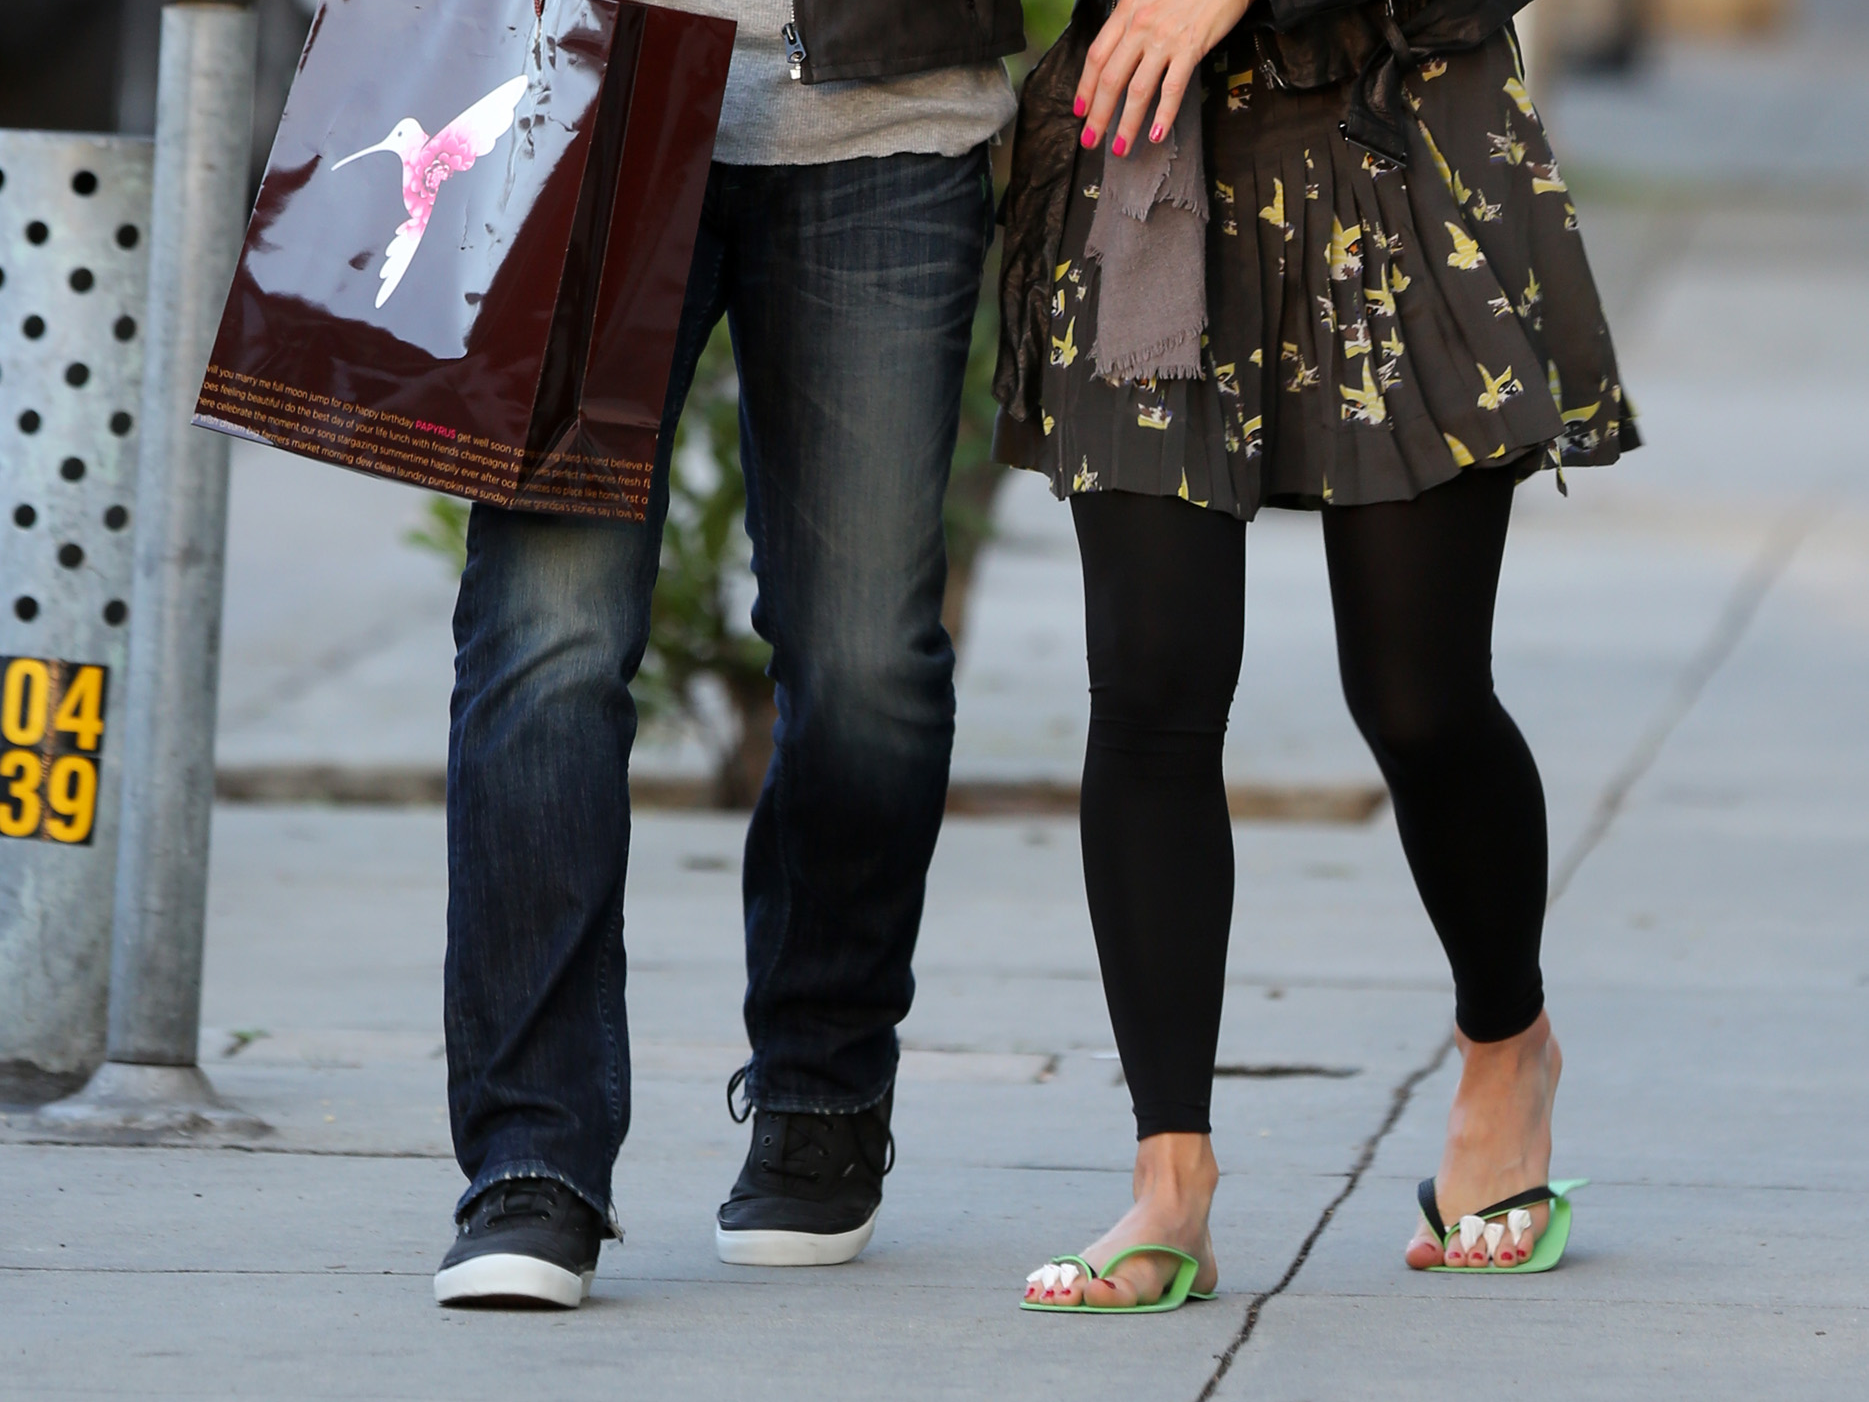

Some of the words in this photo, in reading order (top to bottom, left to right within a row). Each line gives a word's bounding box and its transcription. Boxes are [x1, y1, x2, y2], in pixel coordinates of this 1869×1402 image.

[216, 402, 253, 419] celebrate
[253, 411, 267, 422] the
[267, 416, 300, 432] moment
[301, 425, 316, 435] our
[317, 429, 336, 442] song
[337, 434, 378, 454] stargazing
[379, 444, 429, 467] summertime
[430, 458, 460, 476] happily
[461, 468, 480, 479] ever
[480, 472, 500, 485] after
[551, 486, 562, 495] no
[563, 487, 584, 498] place
[585, 488, 598, 499] like
[598, 490, 621, 501] home
[219, 369, 235, 379] you
[235, 373, 257, 387] marry
[259, 379, 271, 390] me
[272, 381, 284, 393] full
[285, 387, 308, 399] moon
[309, 392, 329, 406] jump
[331, 397, 342, 408] for
[342, 402, 354, 413] joy
[355, 404, 379, 420] happy
[380, 411, 414, 429] birthday
[415, 420, 456, 440] PAPYRUS
[457, 433, 471, 444] get
[473, 438, 489, 448] well
[490, 442, 512, 454] soon
[610, 458, 643, 471] believe
[221, 384, 246, 401] feeling
[247, 391, 280, 408] beautiful
[284, 403, 296, 413] do
[297, 406, 311, 417] the
[312, 409, 330, 423] best
[331, 415, 345, 428] day
[345, 419, 355, 428] of
[355, 423, 374, 434] your
[375, 427, 388, 438] life
[389, 430, 410, 444] lunch
[411, 438, 430, 449] with
[431, 441, 459, 457] friends
[460, 450, 509, 470] champagne
[552, 470, 579, 480] perfect
[580, 473, 617, 484] memories
[617, 475, 641, 487] fresh
[261, 429, 290, 446] farmers
[291, 439, 320, 454] market
[321, 447, 354, 465] morning
[355, 455, 373, 468] dew
[374, 461, 396, 474] clean
[397, 466, 428, 484] laundry
[428, 476, 464, 493] pumpkin
[464, 486, 479, 497] pie
[479, 489, 509, 506] sunday
[597, 507, 611, 518] say
[616, 507, 632, 519] love
[2, 657, 104, 751] 04
[0, 749, 97, 843] 39
